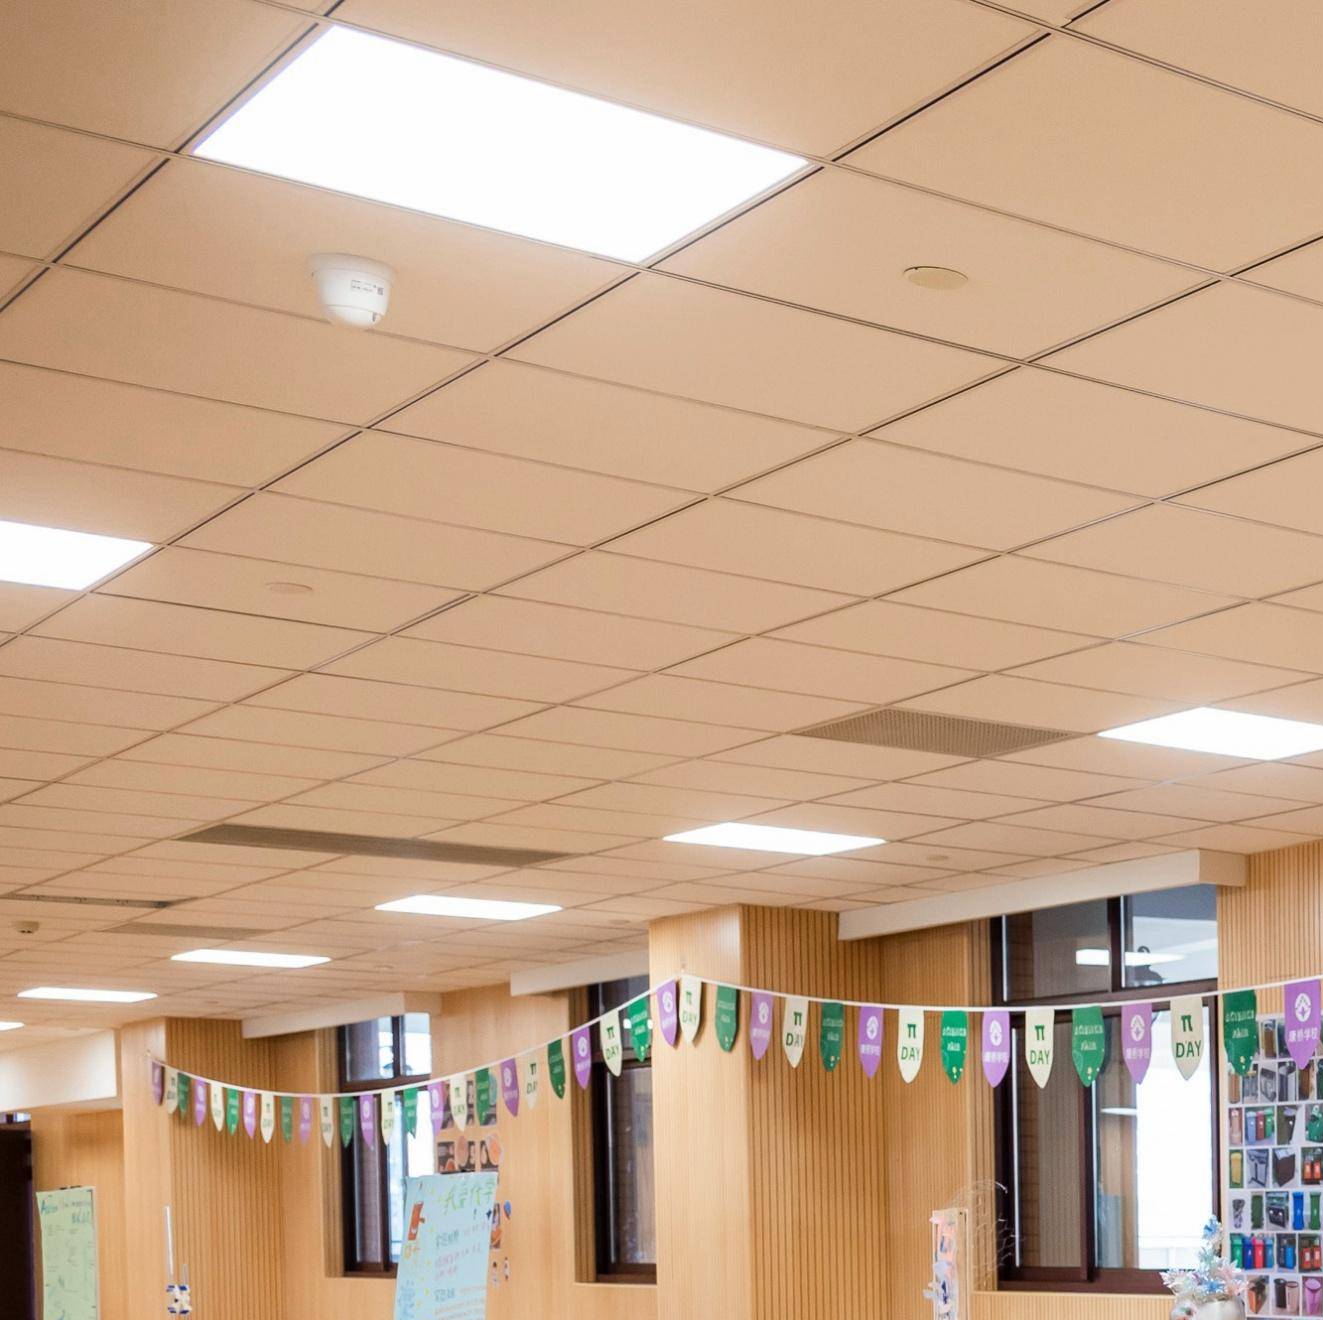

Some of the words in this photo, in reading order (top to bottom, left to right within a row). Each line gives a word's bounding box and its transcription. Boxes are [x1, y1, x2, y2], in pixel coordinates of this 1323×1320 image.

[900, 1046, 921, 1061] DAY
[1029, 1049, 1050, 1065] DAY
[1175, 1039, 1202, 1059] DAY
